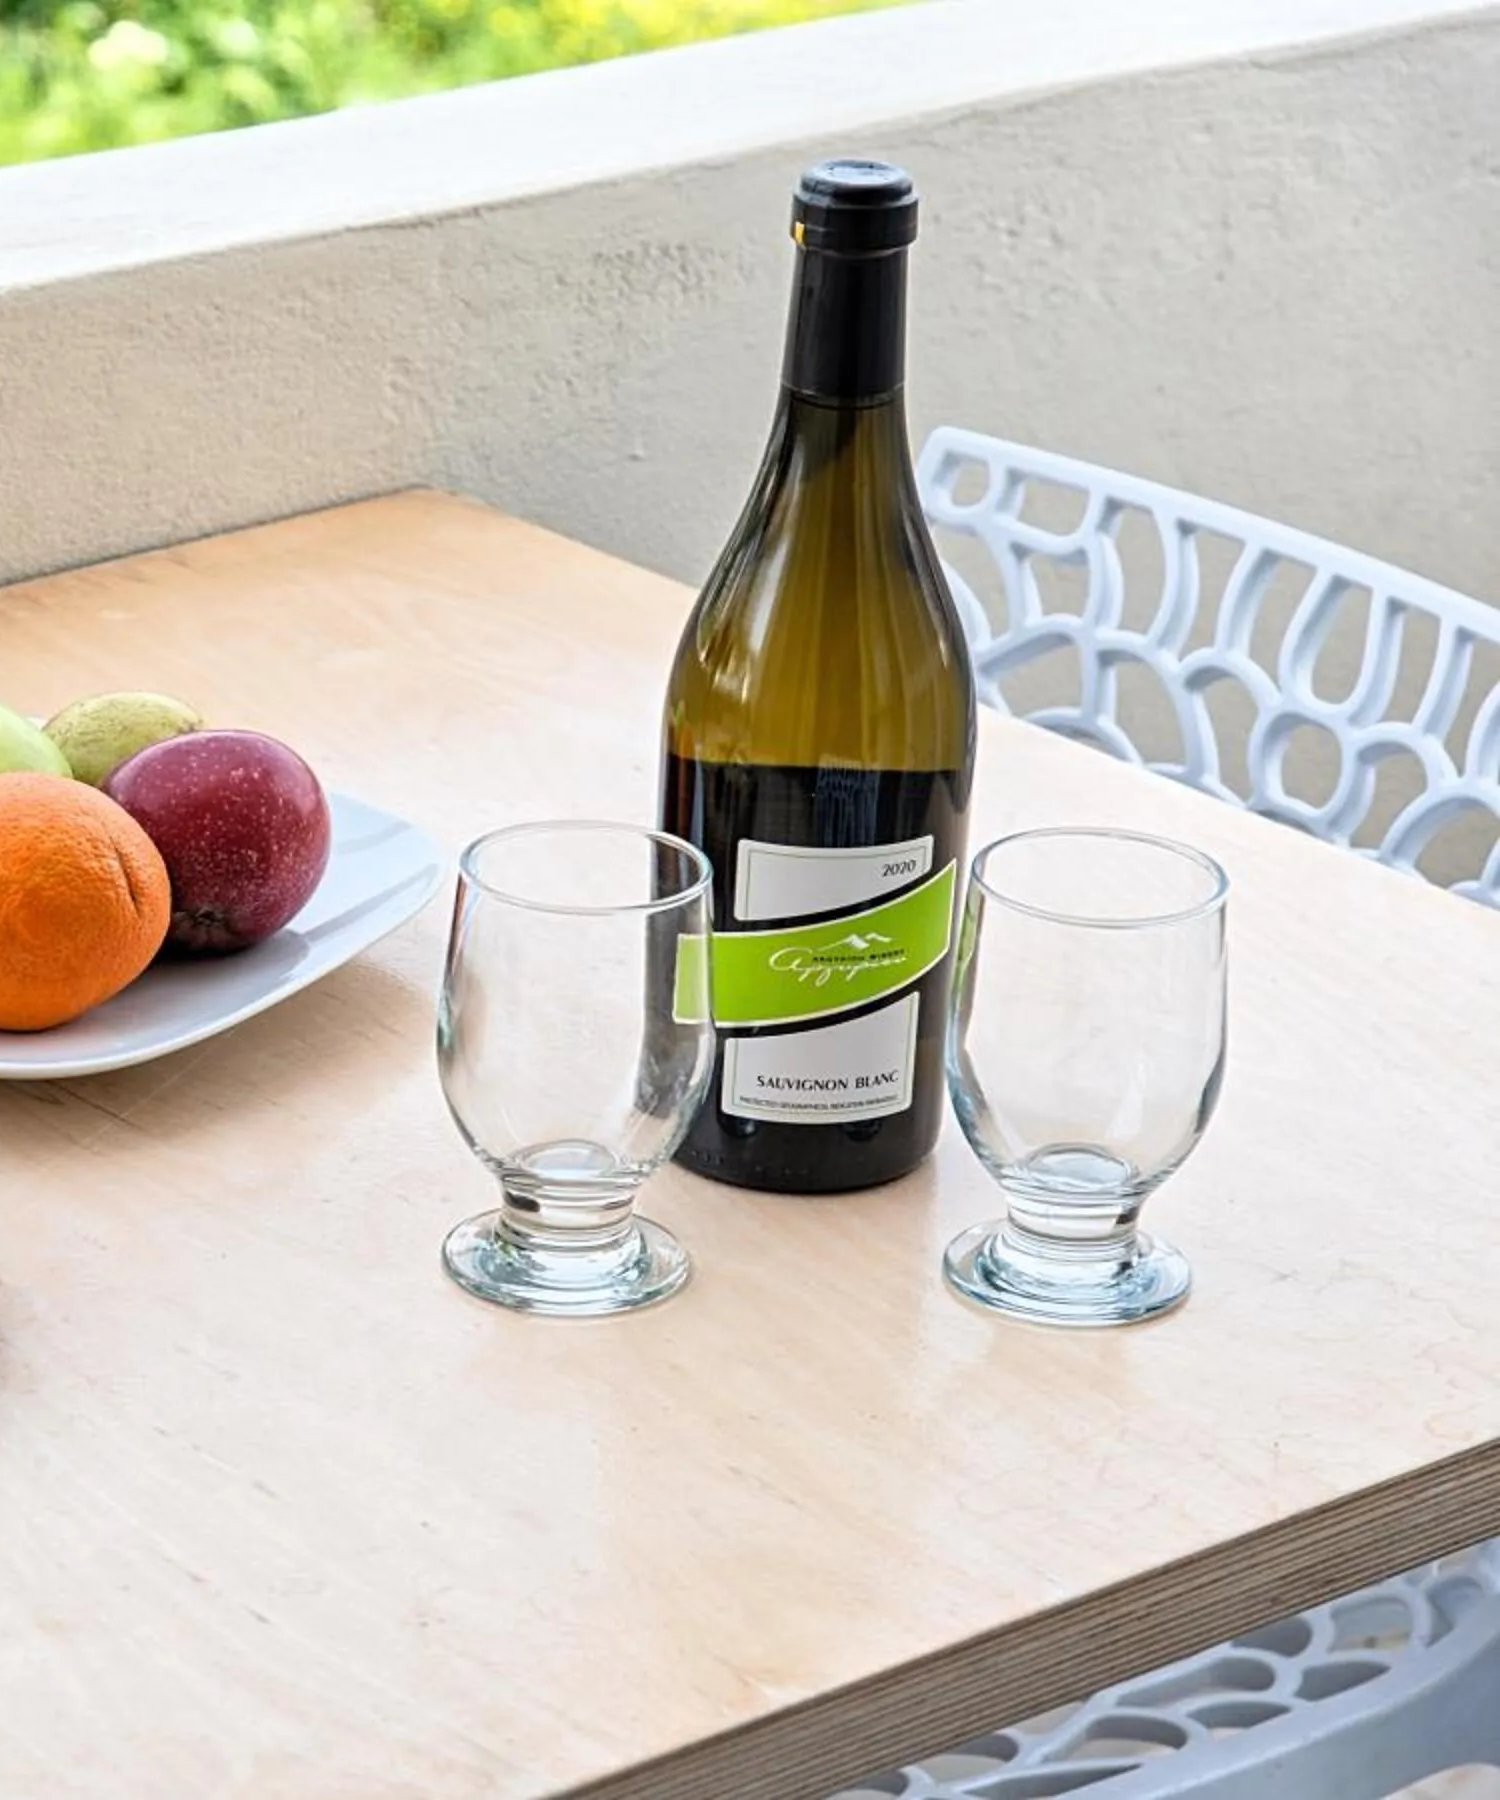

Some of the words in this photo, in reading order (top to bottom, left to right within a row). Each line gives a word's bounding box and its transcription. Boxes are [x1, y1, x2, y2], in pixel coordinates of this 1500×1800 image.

[882, 859, 917, 877] 2020
[756, 1074, 849, 1091] SAUVIGNON
[855, 1069, 899, 1090] BLANC
